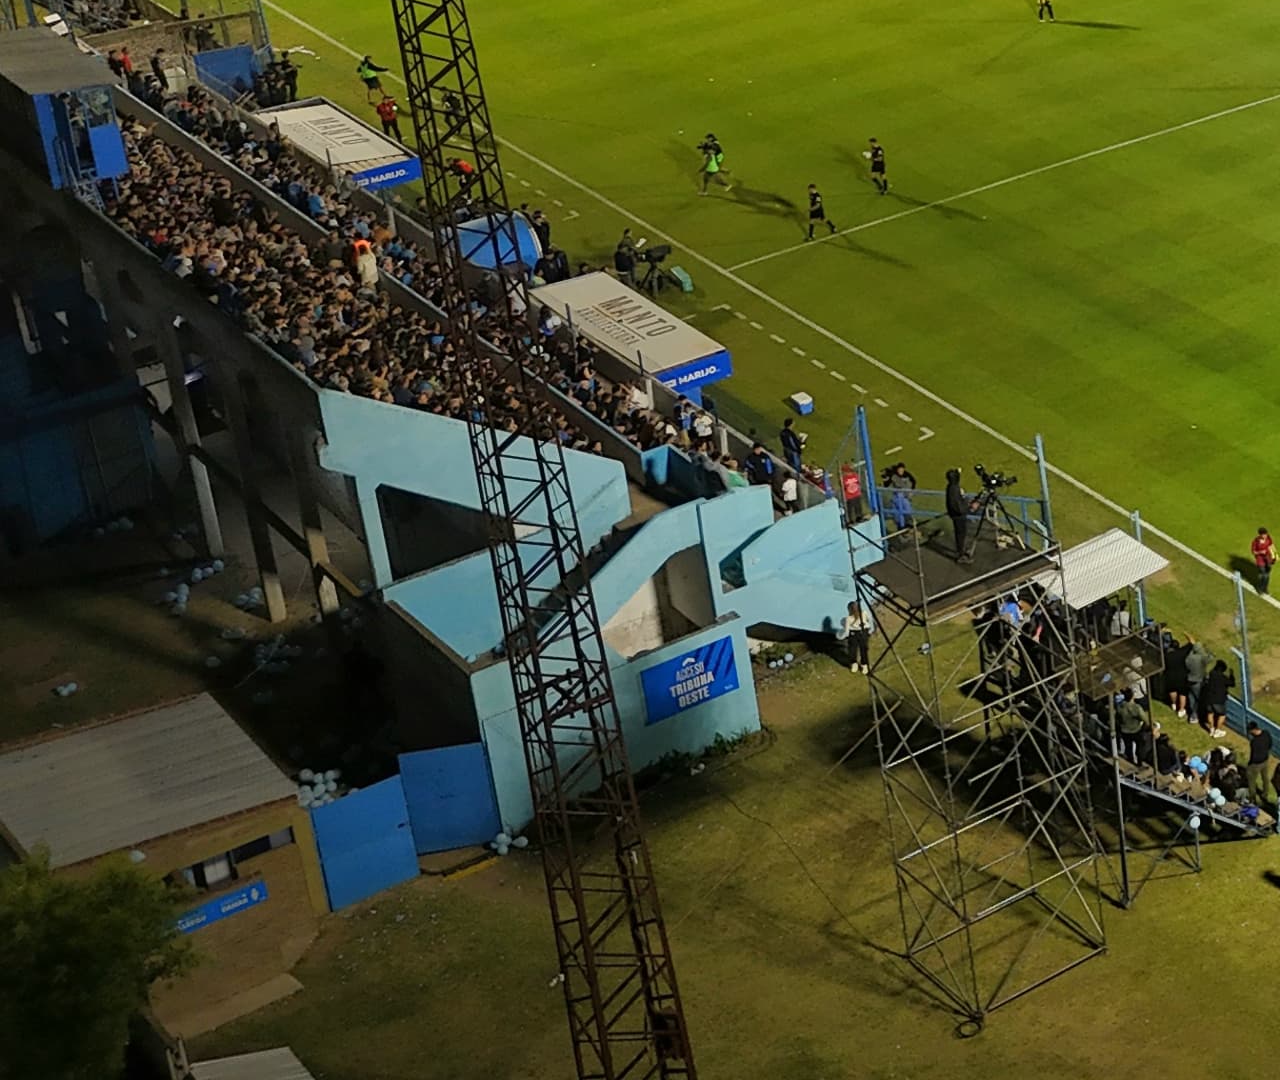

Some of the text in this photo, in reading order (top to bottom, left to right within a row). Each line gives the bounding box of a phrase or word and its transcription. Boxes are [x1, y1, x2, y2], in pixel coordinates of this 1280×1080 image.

[310, 117, 370, 145] MANTO
[371, 169, 406, 184] MARIJO
[600, 296, 678, 337] MANTO
[678, 366, 717, 385] MARIJO
[676, 661, 705, 682] ACCESO
[669, 671, 715, 698] TRIBUNA
[679, 686, 710, 708] OESTE
